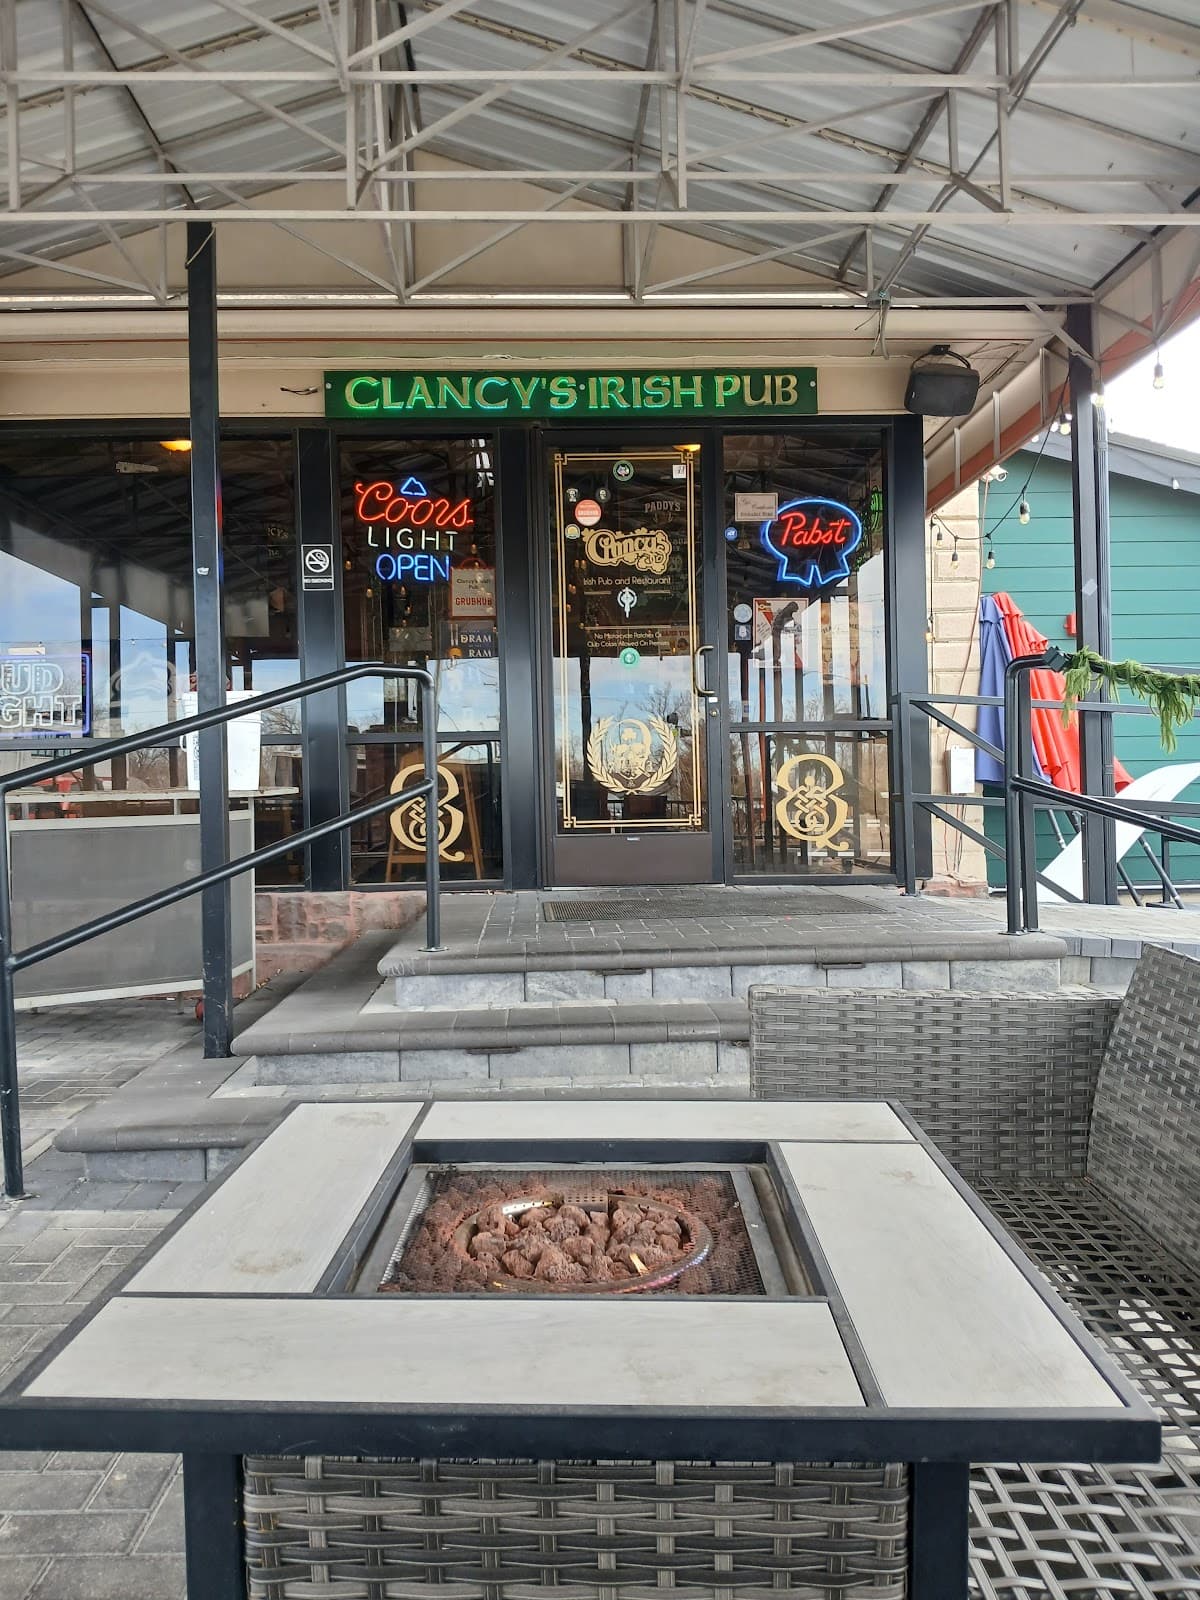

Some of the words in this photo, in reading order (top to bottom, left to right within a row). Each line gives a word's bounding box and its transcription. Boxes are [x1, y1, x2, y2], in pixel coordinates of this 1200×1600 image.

[344, 376, 577, 409] CLANCY'S
[588, 375, 704, 408] IRISH
[714, 374, 798, 407] PUB
[354, 482, 474, 527] Coors
[367, 526, 458, 551] LIGHT
[781, 512, 851, 546] Pabst
[375, 553, 450, 582] OPEN
[598, 576, 612, 585] Pub
[615, 576, 630, 585] and
[455, 597, 493, 606] GRUBHUB
